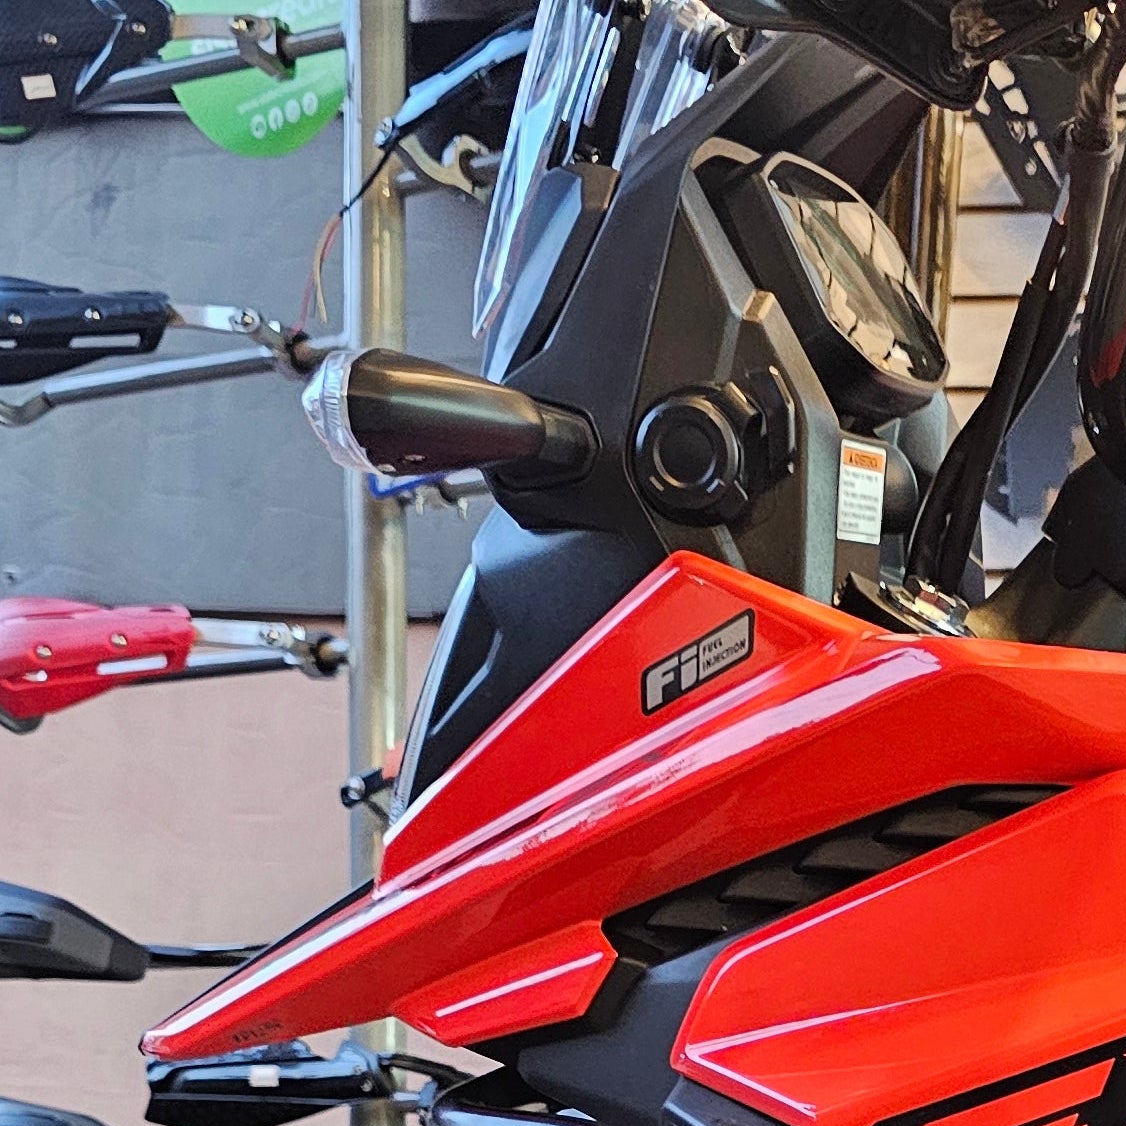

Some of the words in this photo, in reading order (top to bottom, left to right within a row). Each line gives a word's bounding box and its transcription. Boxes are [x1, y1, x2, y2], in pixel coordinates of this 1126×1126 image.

[702, 638, 747, 672] INJECTION
[703, 638, 723, 657] FUEL
[646, 644, 698, 711] Fi
